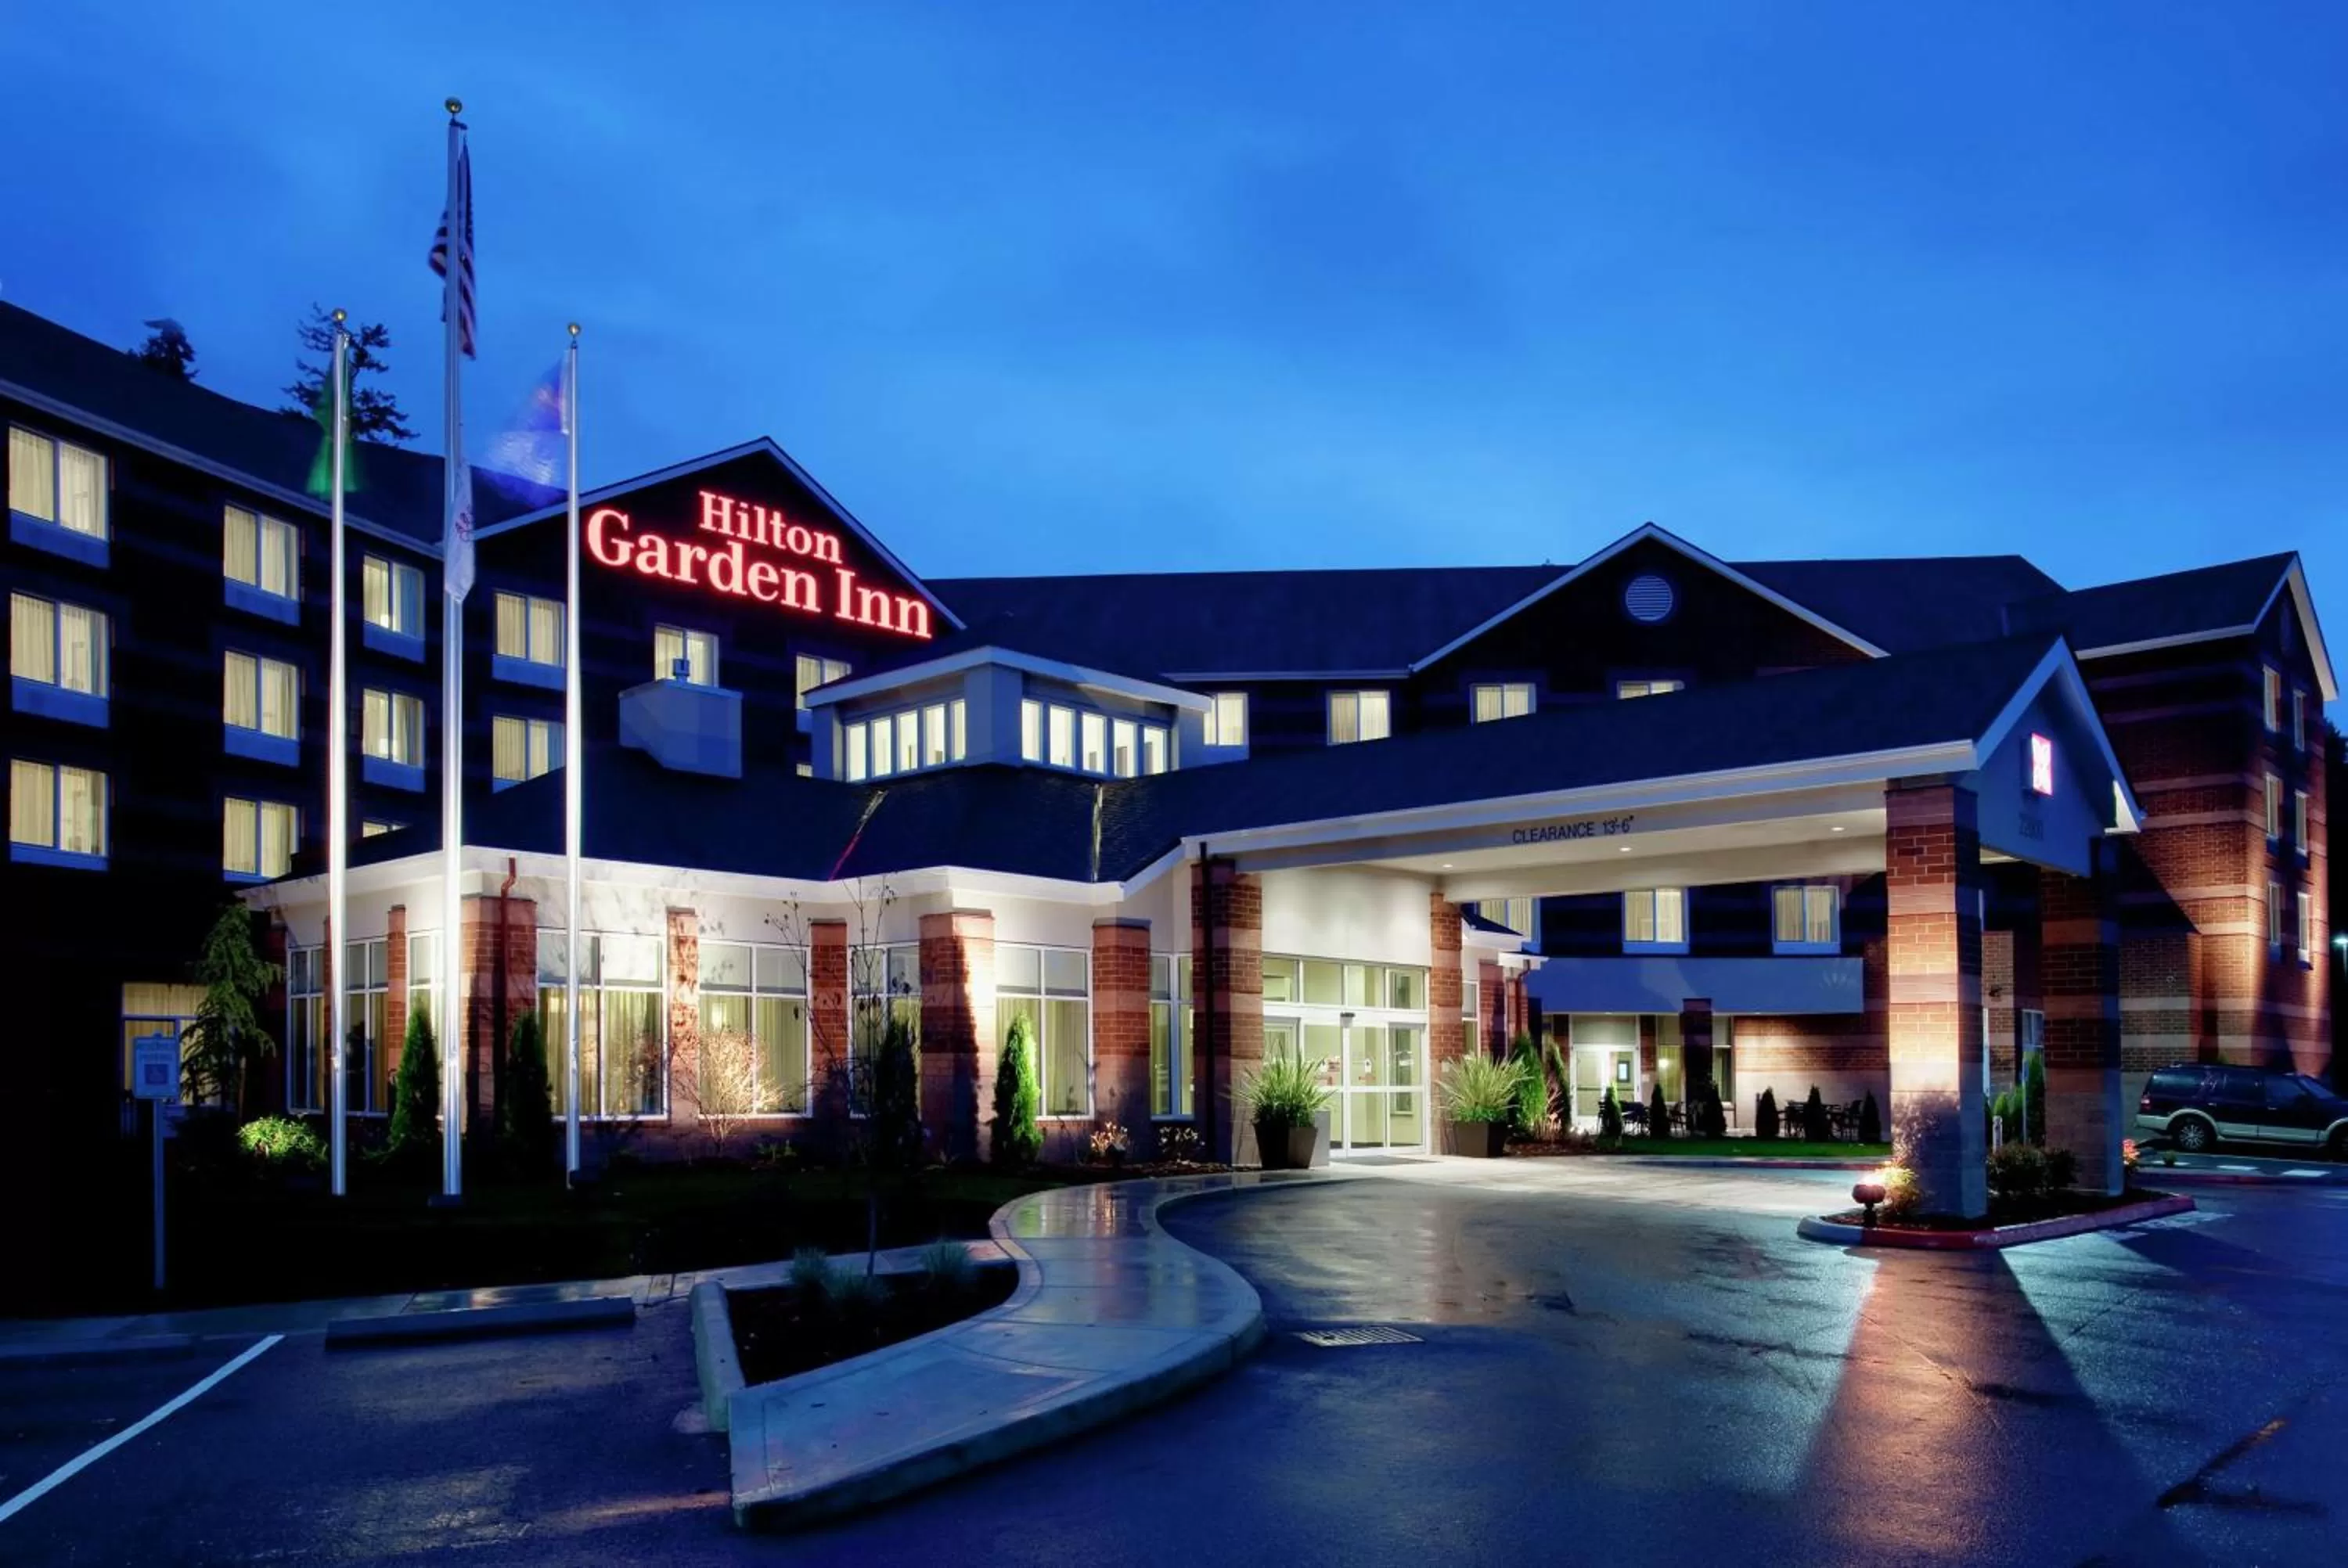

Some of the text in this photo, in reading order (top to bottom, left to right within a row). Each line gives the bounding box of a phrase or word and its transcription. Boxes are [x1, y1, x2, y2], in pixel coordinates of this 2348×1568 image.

[699, 490, 843, 564] Hilton
[588, 509, 932, 639] Garden Inn
[1512, 822, 1595, 844] CLEARANCE
